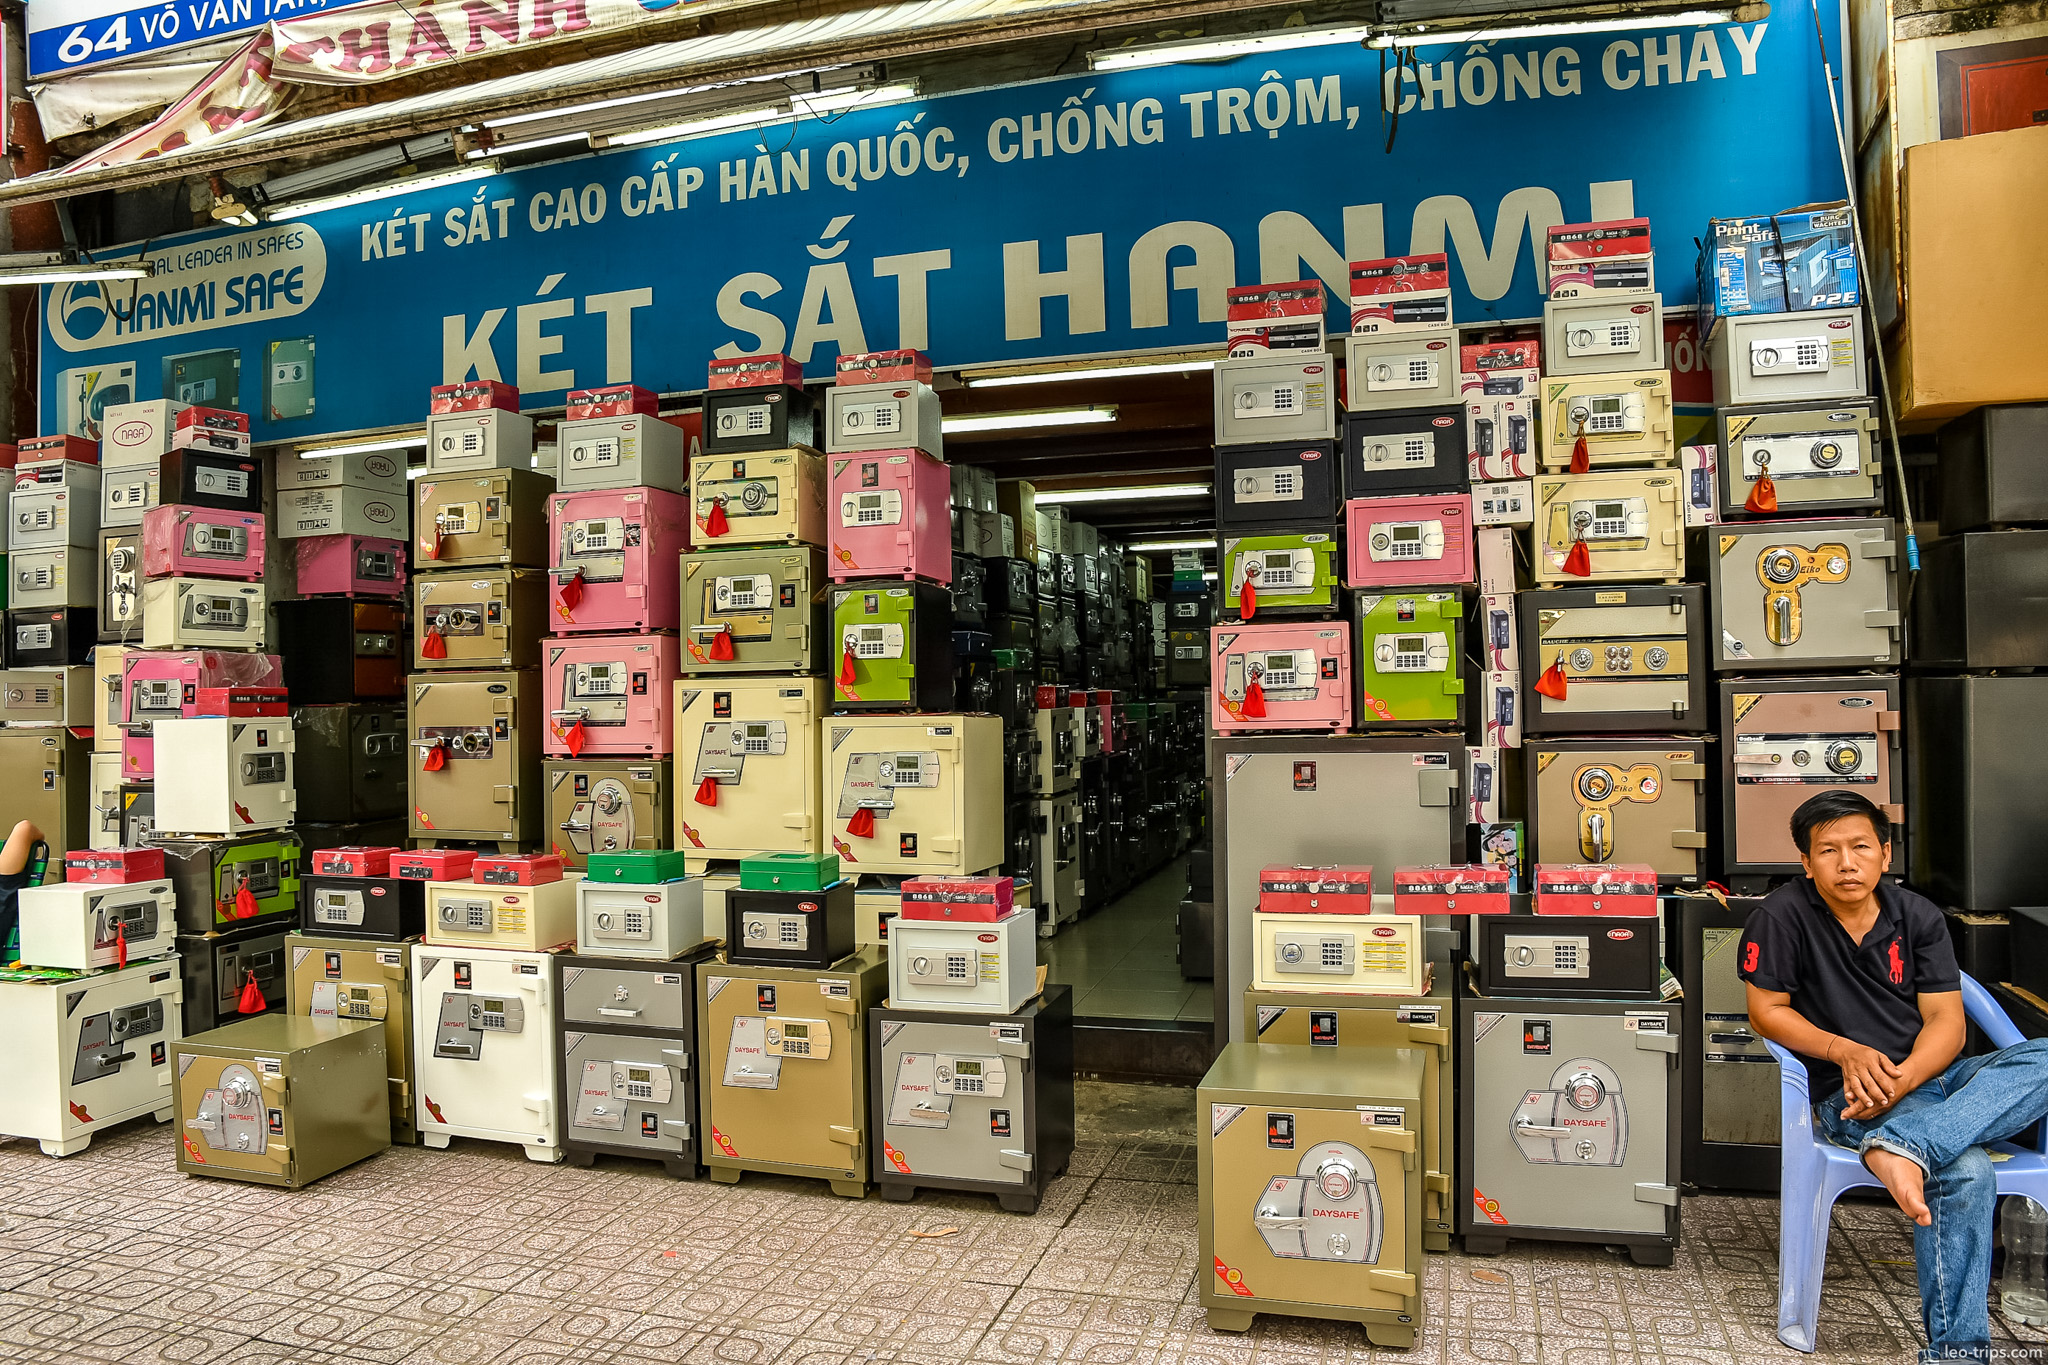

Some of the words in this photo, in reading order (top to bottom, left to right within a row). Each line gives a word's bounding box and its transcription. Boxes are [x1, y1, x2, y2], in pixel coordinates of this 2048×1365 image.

[58, 15, 132, 64] 64
[139, 4, 180, 43] VÕ
[361, 207, 432, 262] KÉT
[443, 185, 515, 248] SẮT
[528, 183, 607, 233] CAO
[619, 152, 704, 219] CẤP
[719, 142, 811, 204] HÀN
[826, 112, 970, 191] QUỐC,
[986, 87, 1165, 164] CHỐNG
[1179, 69, 1360, 140] TRỘM,
[1716, 220, 1760, 237] Point
[1742, 229, 1776, 243] safe
[178, 243, 232, 271] LEADER
[237, 241, 252, 260] IN
[257, 230, 304, 257] SAFES
[114, 281, 216, 337] HANMI
[224, 265, 305, 318] SAFE
[442, 273, 652, 394] KÉT
[713, 214, 952, 364] SẮT
[1810, 291, 1857, 307] P2E
[122, 424, 145, 441] NAGA
[1800, 565, 1820, 573] Eiko
[1743, 941, 1760, 973] 3
[83, 1041, 105, 1051] DAYSAFE
[901, 1084, 929, 1092] DAYSAFE
[228, 1113, 255, 1121] DAYSAFE
[1563, 1118, 1607, 1127] DAYSAFE
[1312, 1208, 1360, 1220] DAYSAFE
